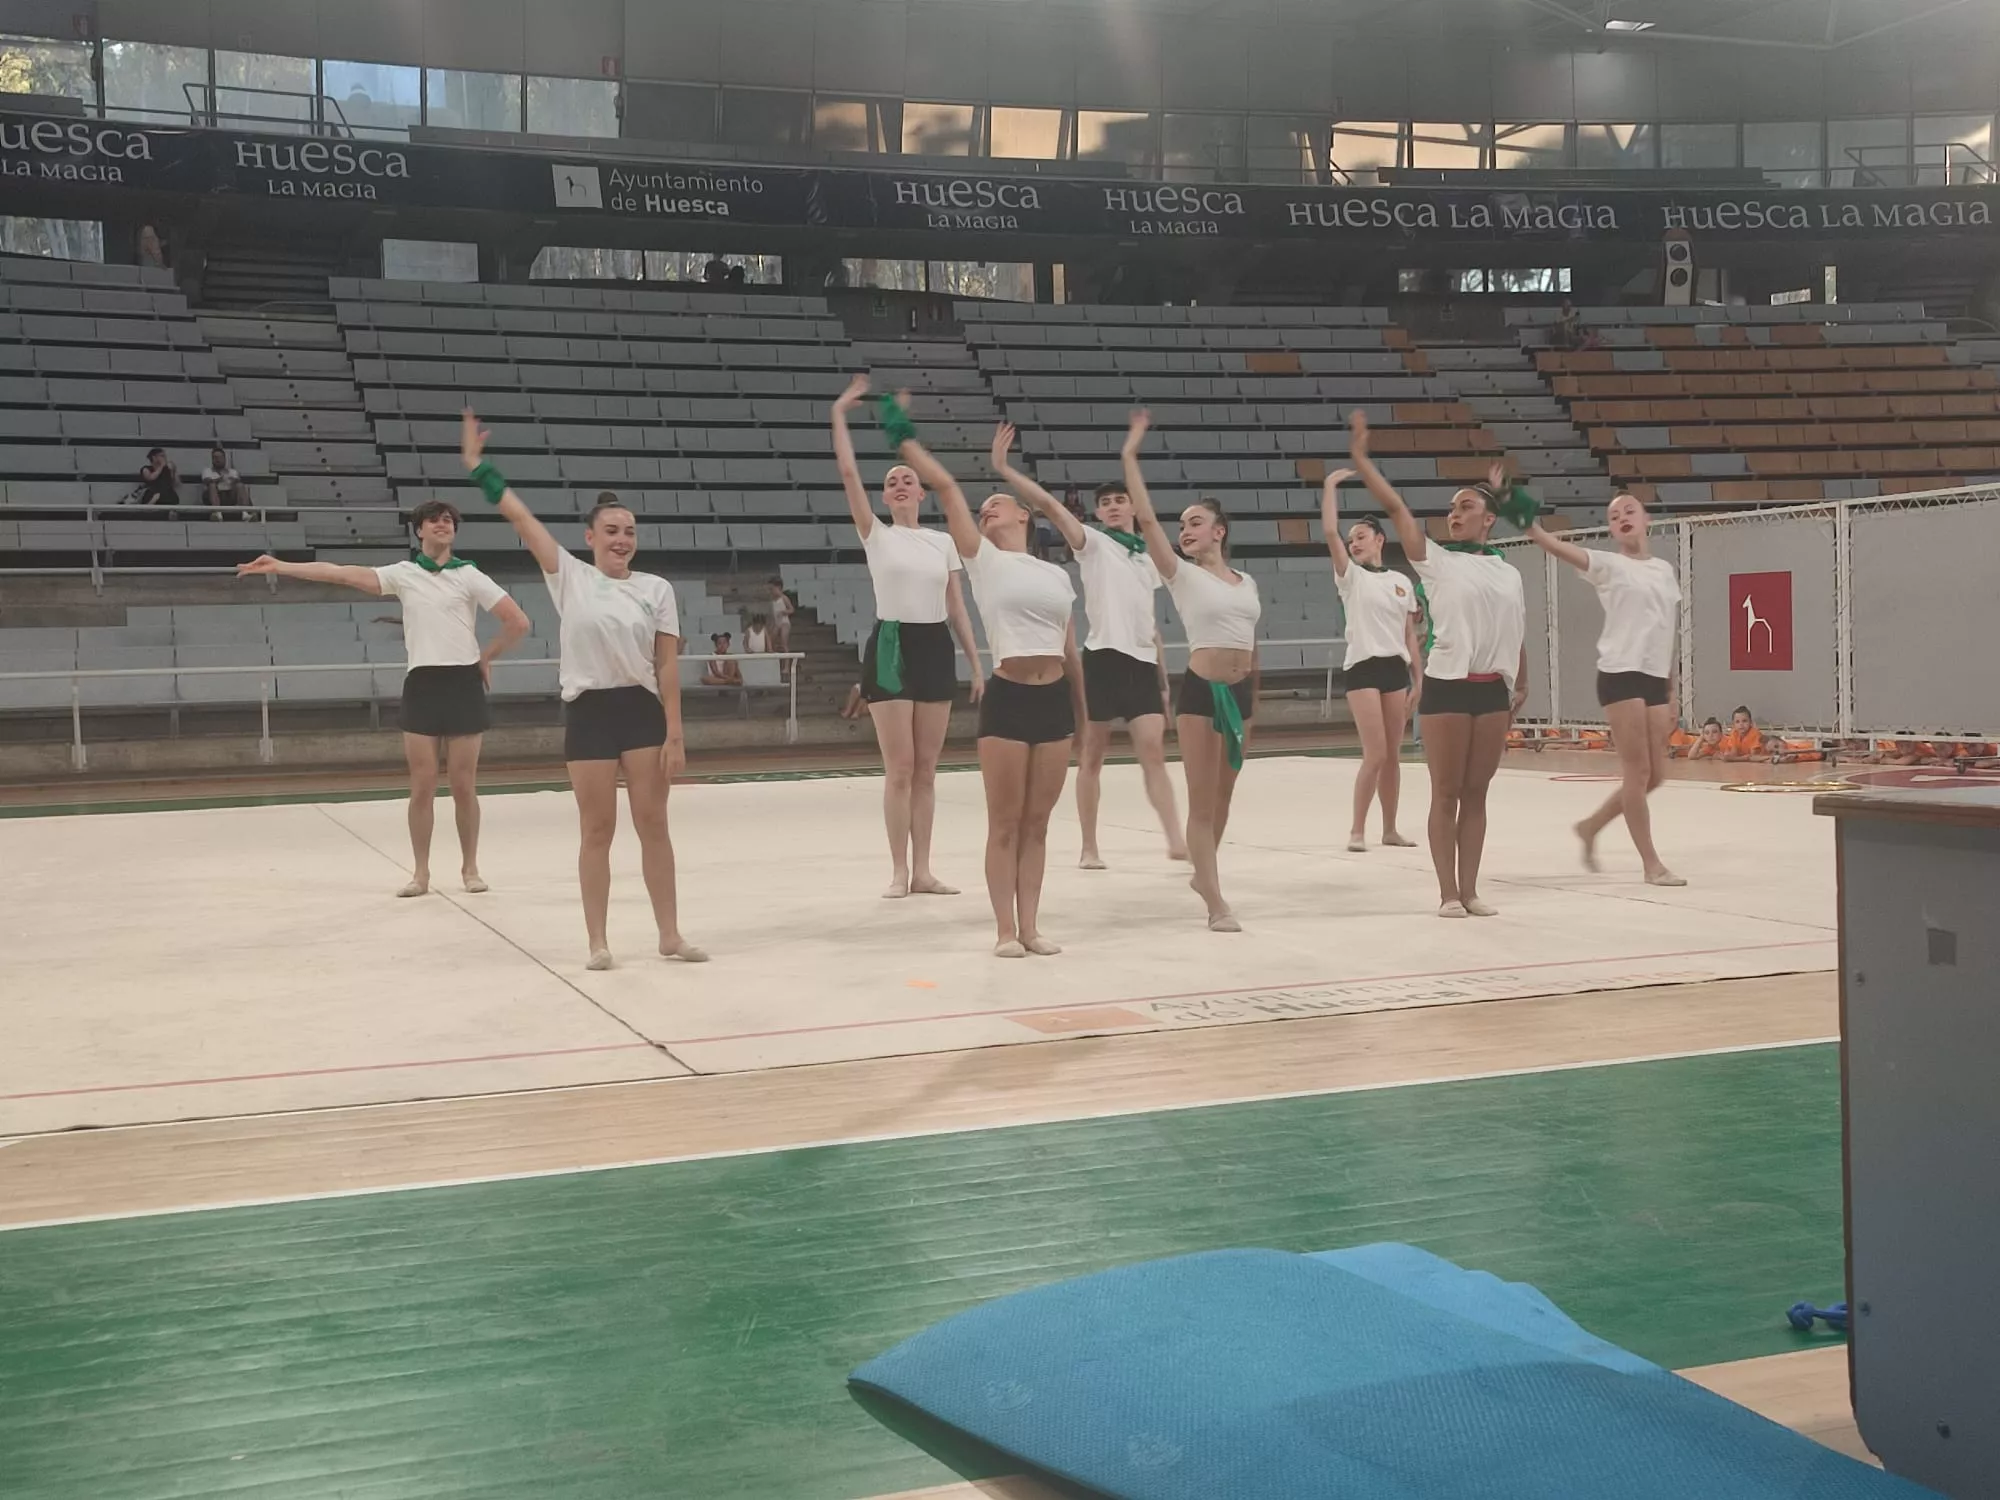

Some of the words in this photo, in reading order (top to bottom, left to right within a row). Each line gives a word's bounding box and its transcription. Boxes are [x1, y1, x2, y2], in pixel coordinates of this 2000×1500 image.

[0, 121, 152, 160] uesca
[234, 141, 411, 178] Huesca
[609, 168, 763, 193] Ayuntamiento
[893, 180, 1041, 209] Huesca
[611, 192, 637, 211] de
[644, 193, 730, 216] Huesca
[1102, 186, 1246, 214] Huesca
[1286, 198, 1440, 228] Huesca
[1661, 200, 1811, 230] Huesca
[1151, 975, 1520, 1012] Ayuntamiento
[1253, 991, 1473, 1014] Huesca
